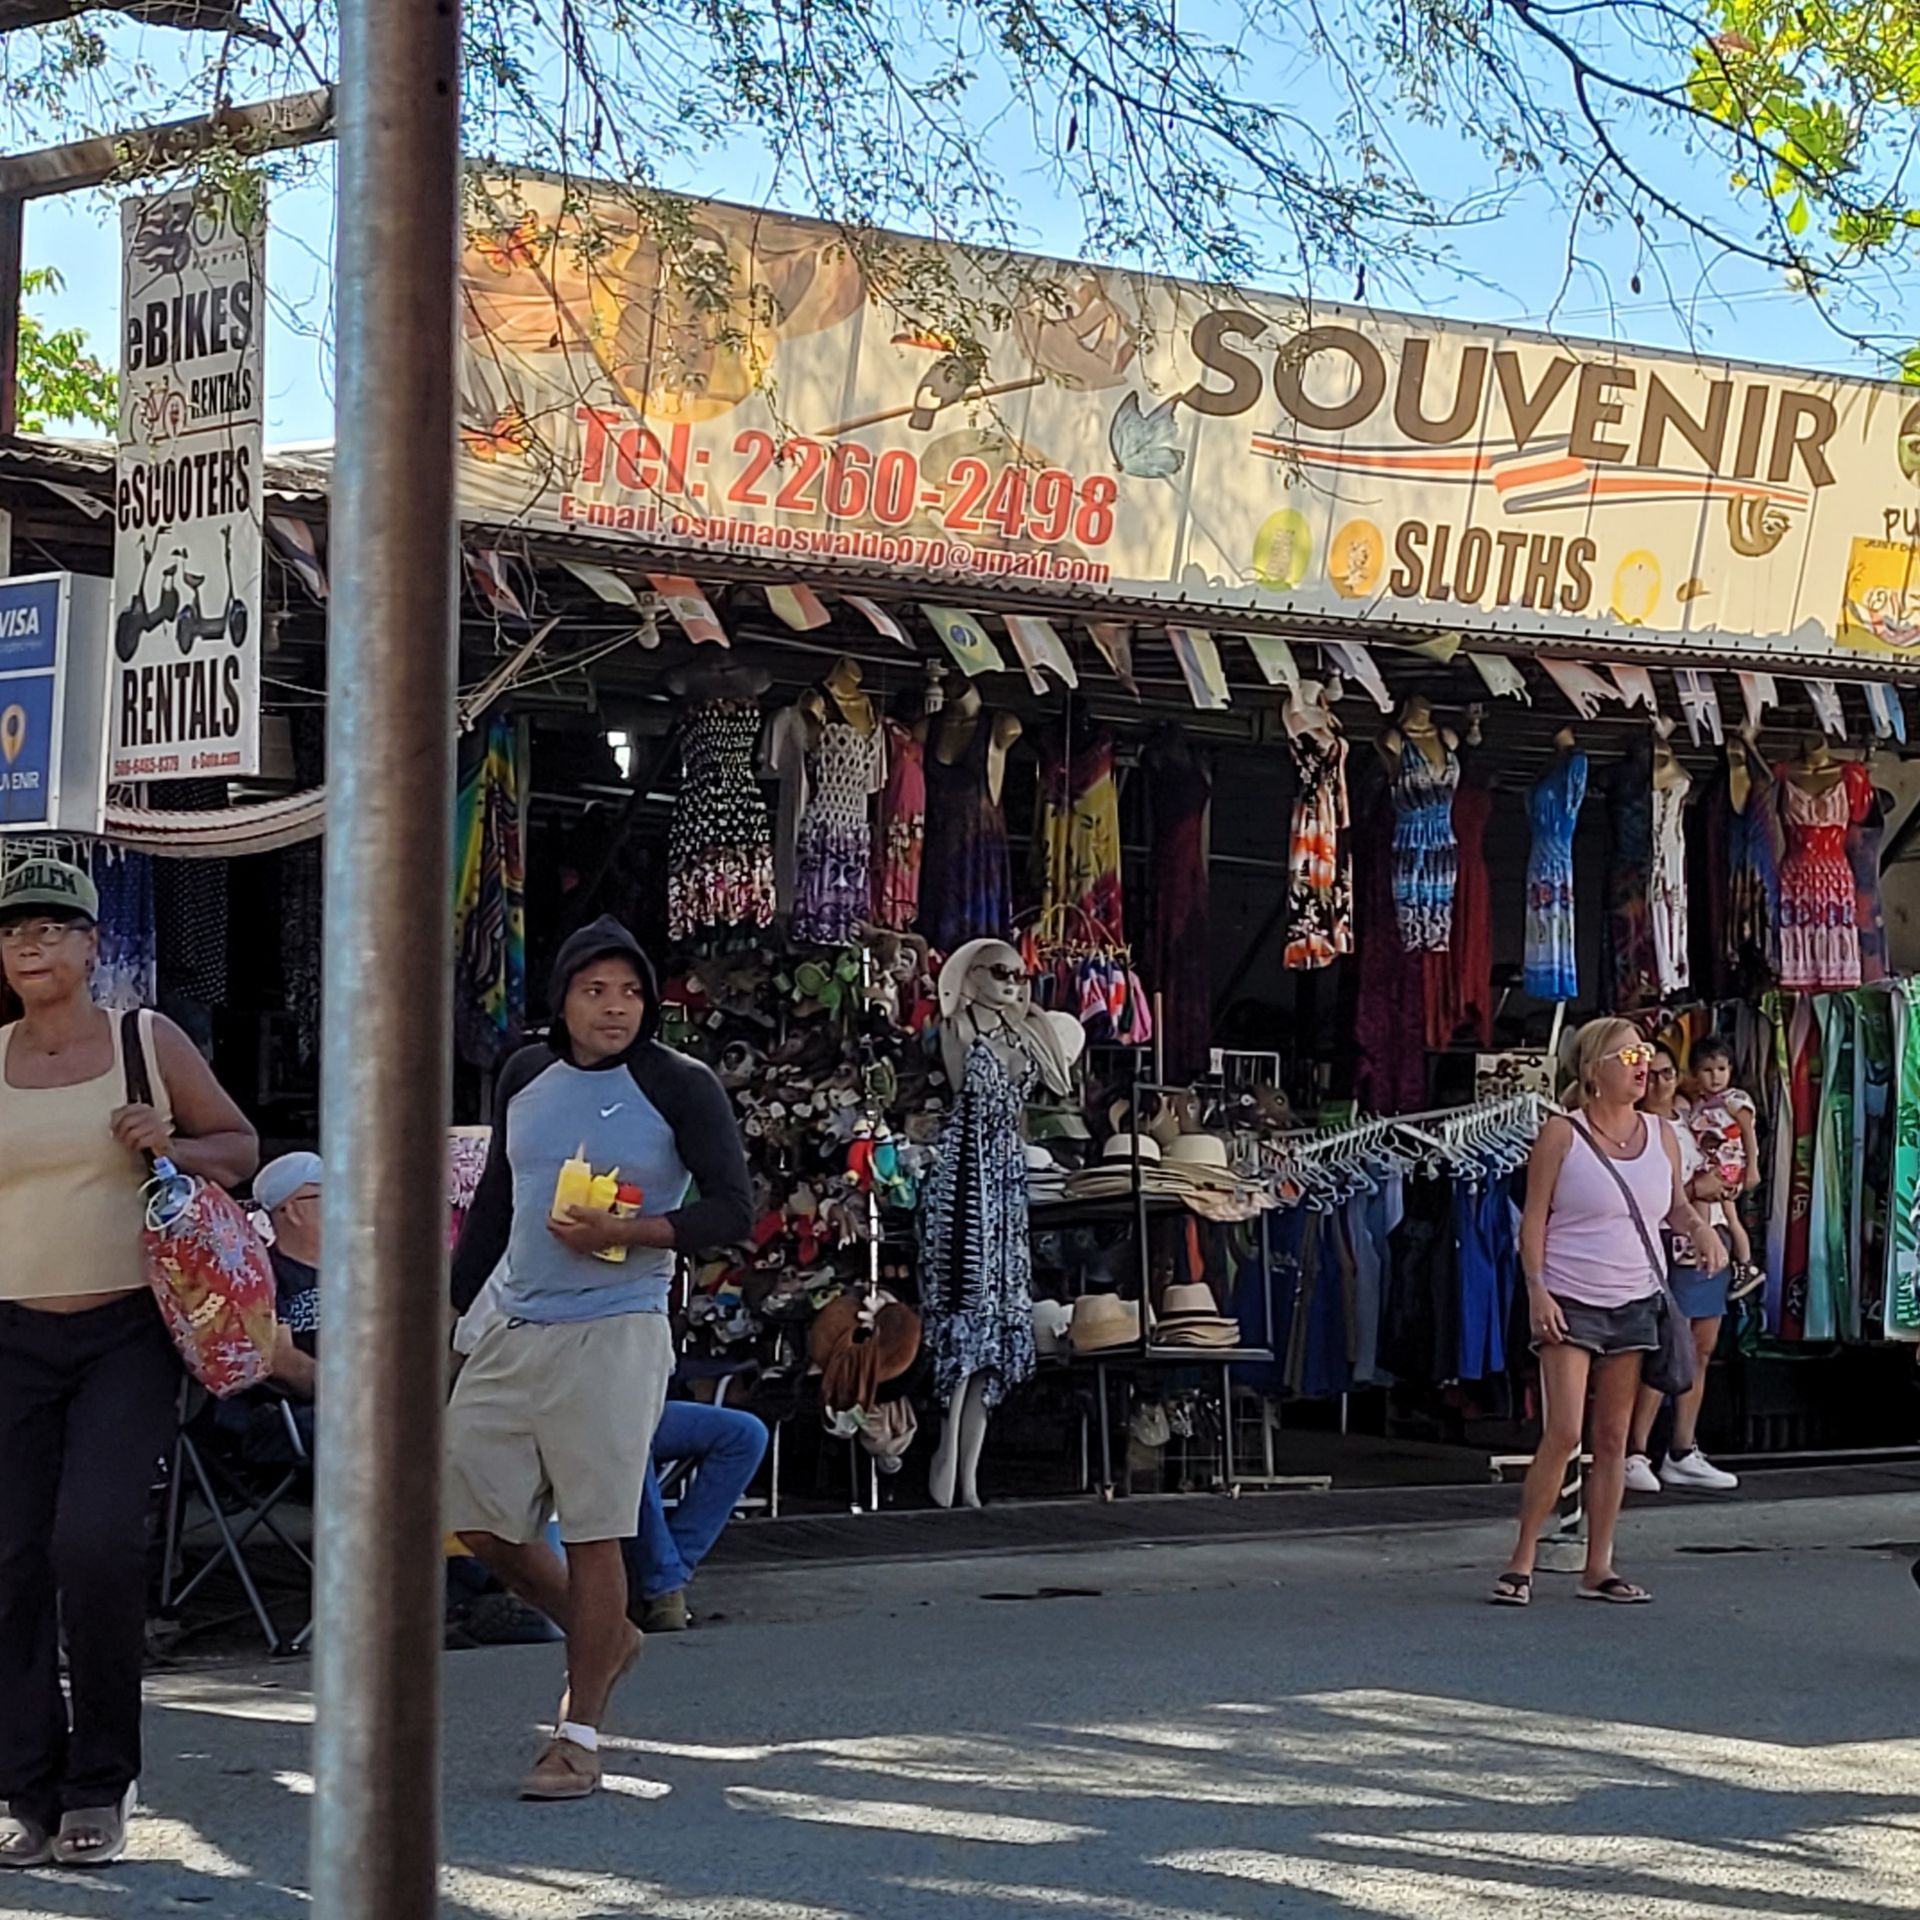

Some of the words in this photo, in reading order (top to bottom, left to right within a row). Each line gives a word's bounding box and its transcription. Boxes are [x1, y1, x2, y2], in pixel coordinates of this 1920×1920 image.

[127, 280, 250, 371] eBIKES
[1177, 308, 1838, 488] SOUVENIR
[118, 445, 250, 532] eSCOOTERS
[576, 403, 711, 499] Tel:
[728, 428, 1117, 545] 2260-2498
[1391, 520, 1597, 612] SLOTHS
[0, 606, 40, 638] VISA
[121, 654, 240, 747] RENTALS
